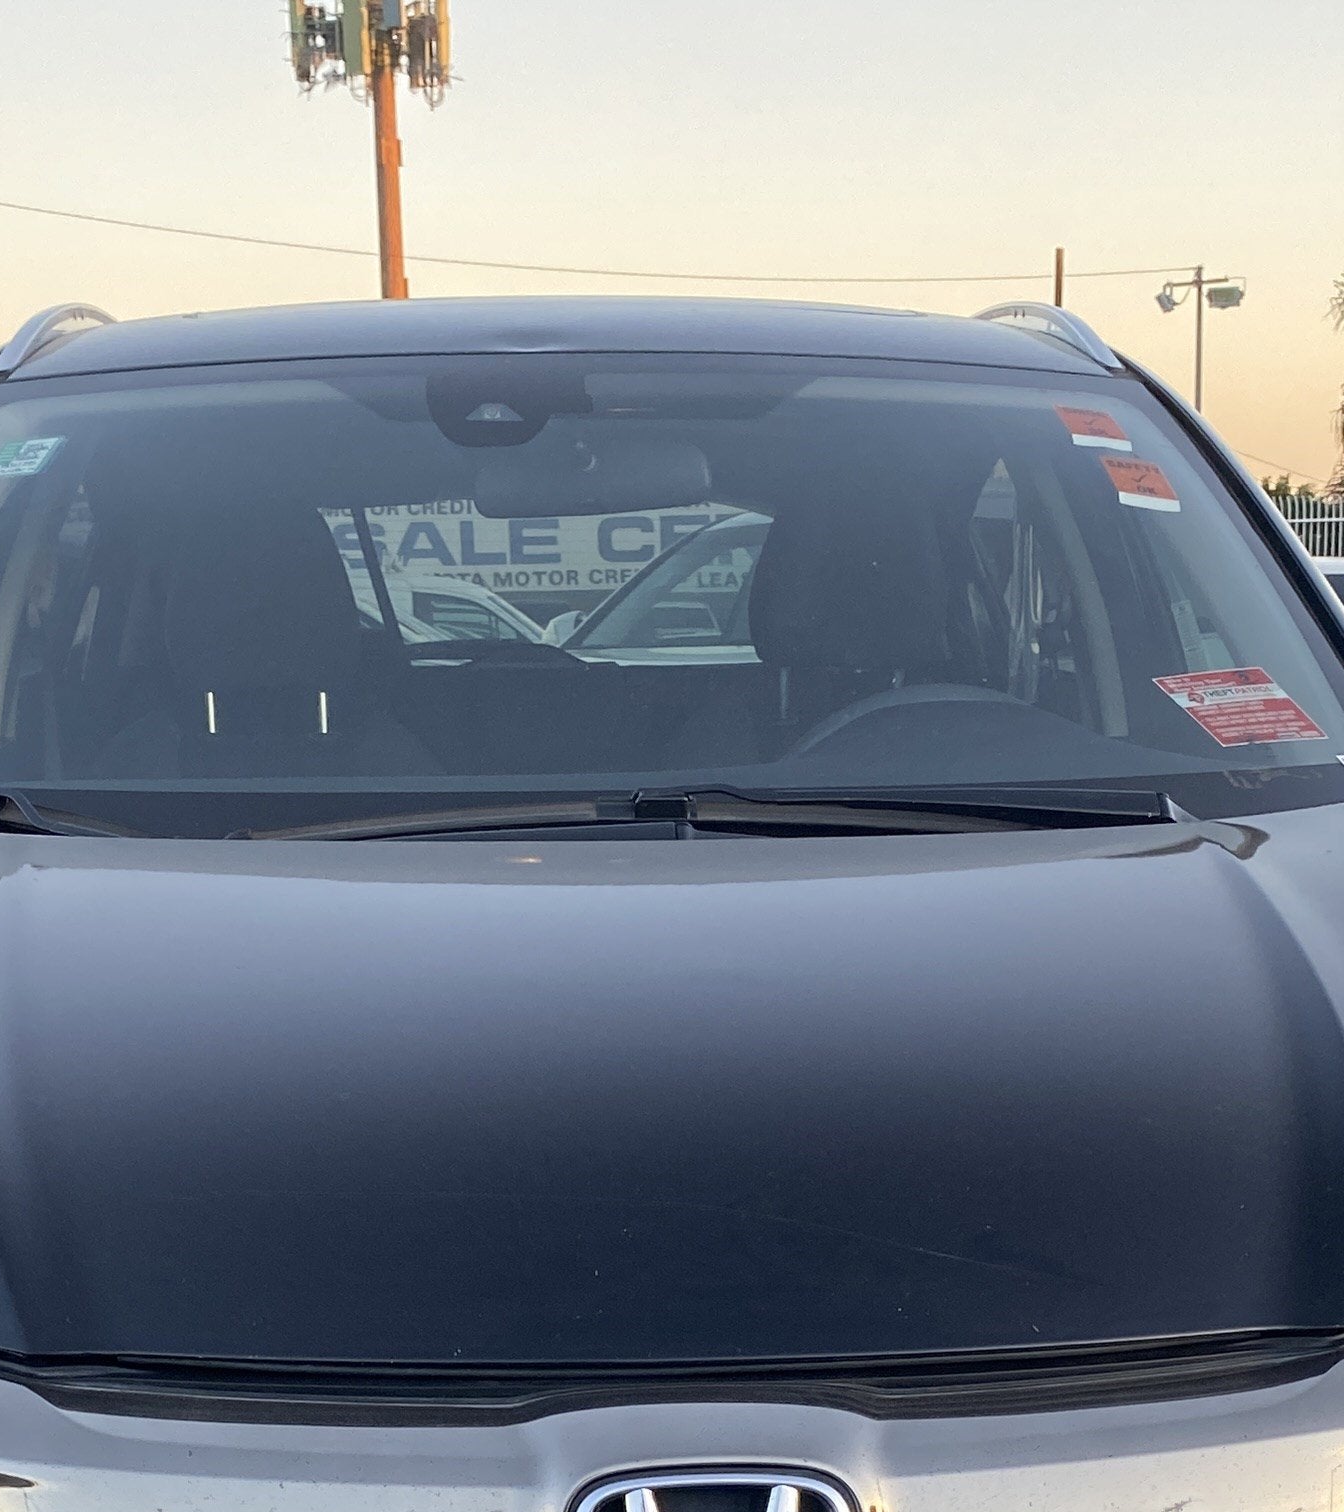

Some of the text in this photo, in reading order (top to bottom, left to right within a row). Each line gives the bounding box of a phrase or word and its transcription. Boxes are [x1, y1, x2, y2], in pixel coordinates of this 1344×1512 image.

[332, 520, 562, 569] SALE
[492, 568, 579, 588] MOTOR
[588, 567, 640, 586] CRE
